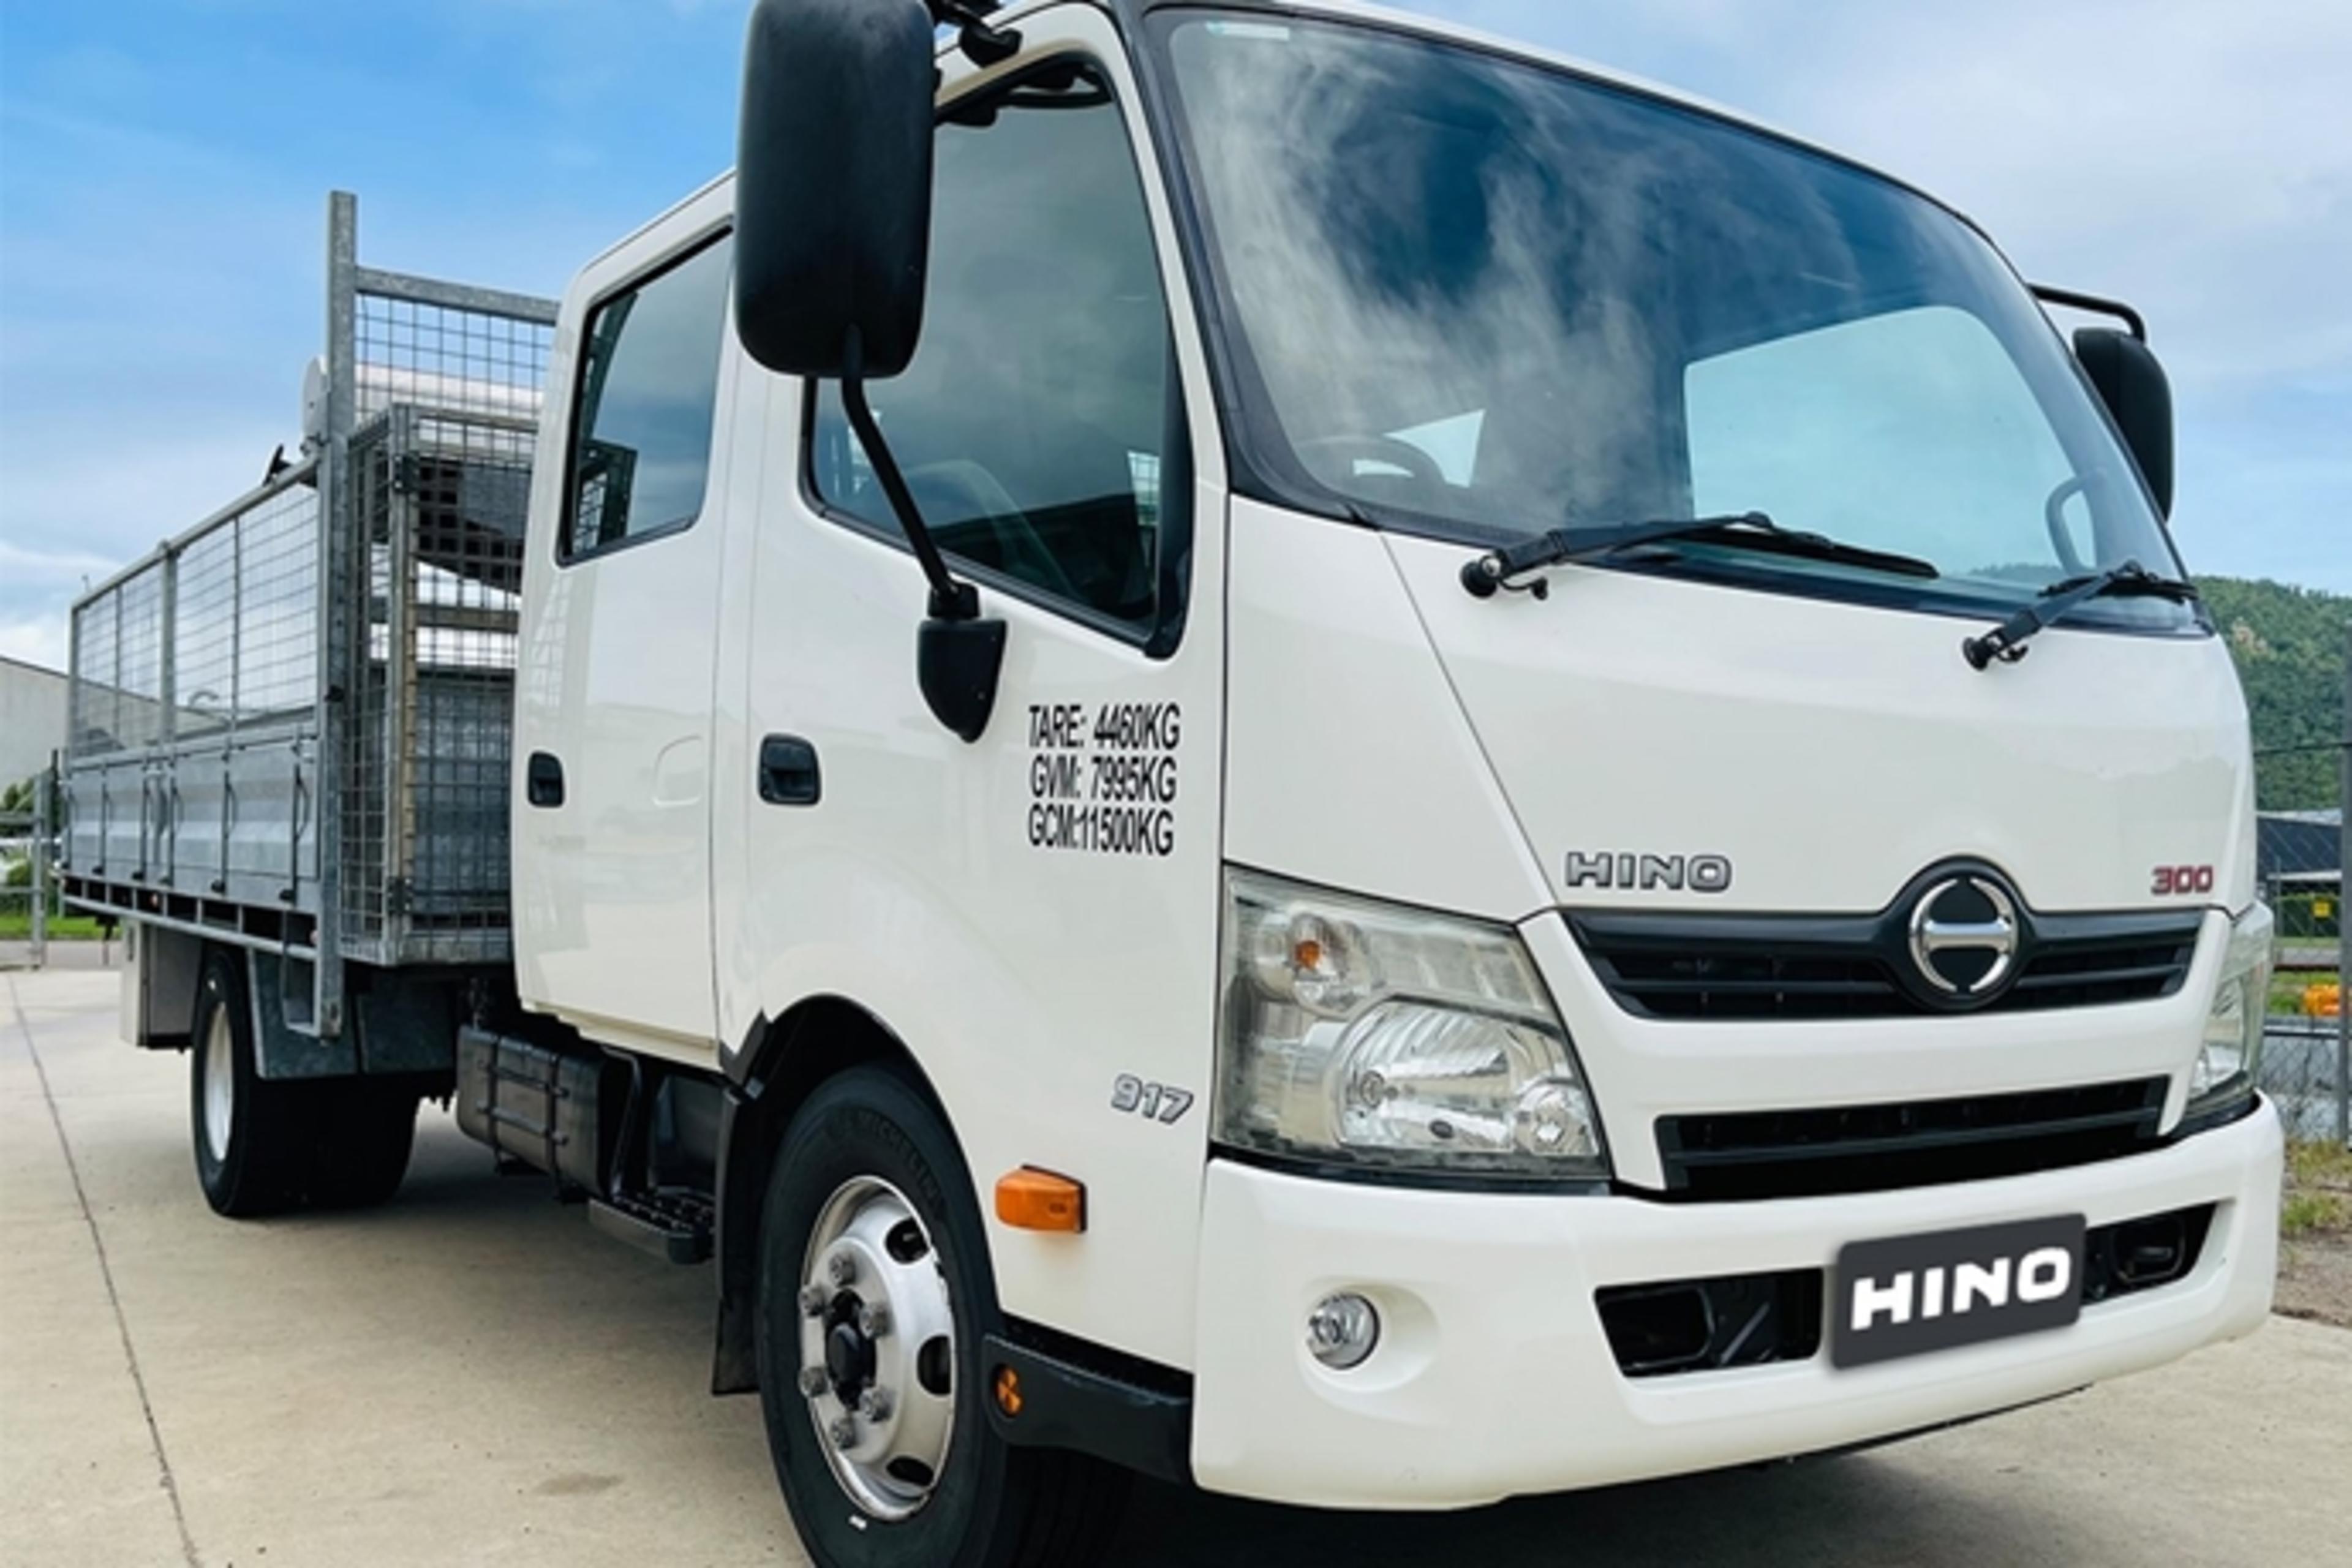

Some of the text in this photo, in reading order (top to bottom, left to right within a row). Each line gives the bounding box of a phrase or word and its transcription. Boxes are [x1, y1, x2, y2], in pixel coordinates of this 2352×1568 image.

[1028, 704, 1085, 747] TARE:
[1030, 755, 1177, 802] GVM: 7995KG
[1566, 851, 1732, 892] HINO
[2150, 865, 2214, 895] 300
[1110, 1073, 1194, 1125] 917
[1850, 1246, 2071, 1331] HINO
